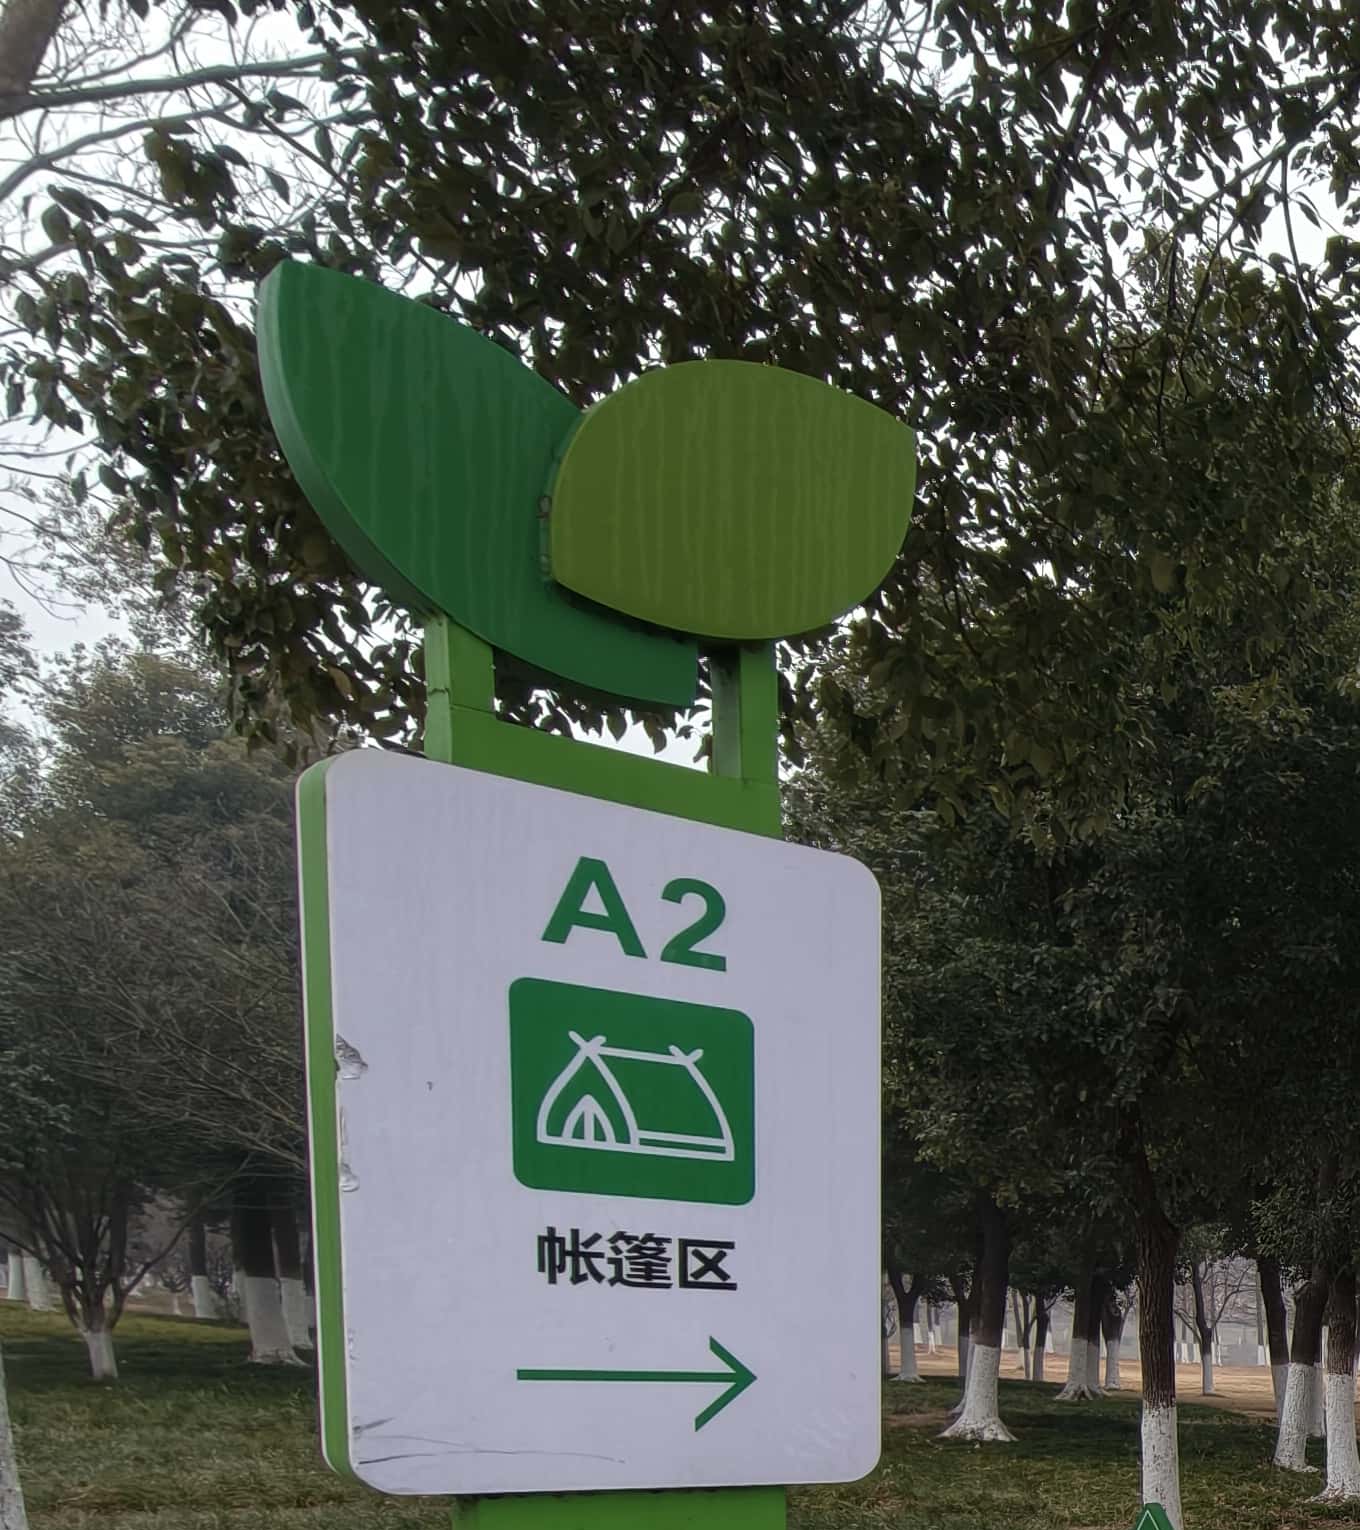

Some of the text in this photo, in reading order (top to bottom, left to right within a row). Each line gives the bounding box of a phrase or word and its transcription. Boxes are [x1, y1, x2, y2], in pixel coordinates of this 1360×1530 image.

[541, 856, 727, 972] A2
[537, 1226, 738, 1291] 帐篷区
